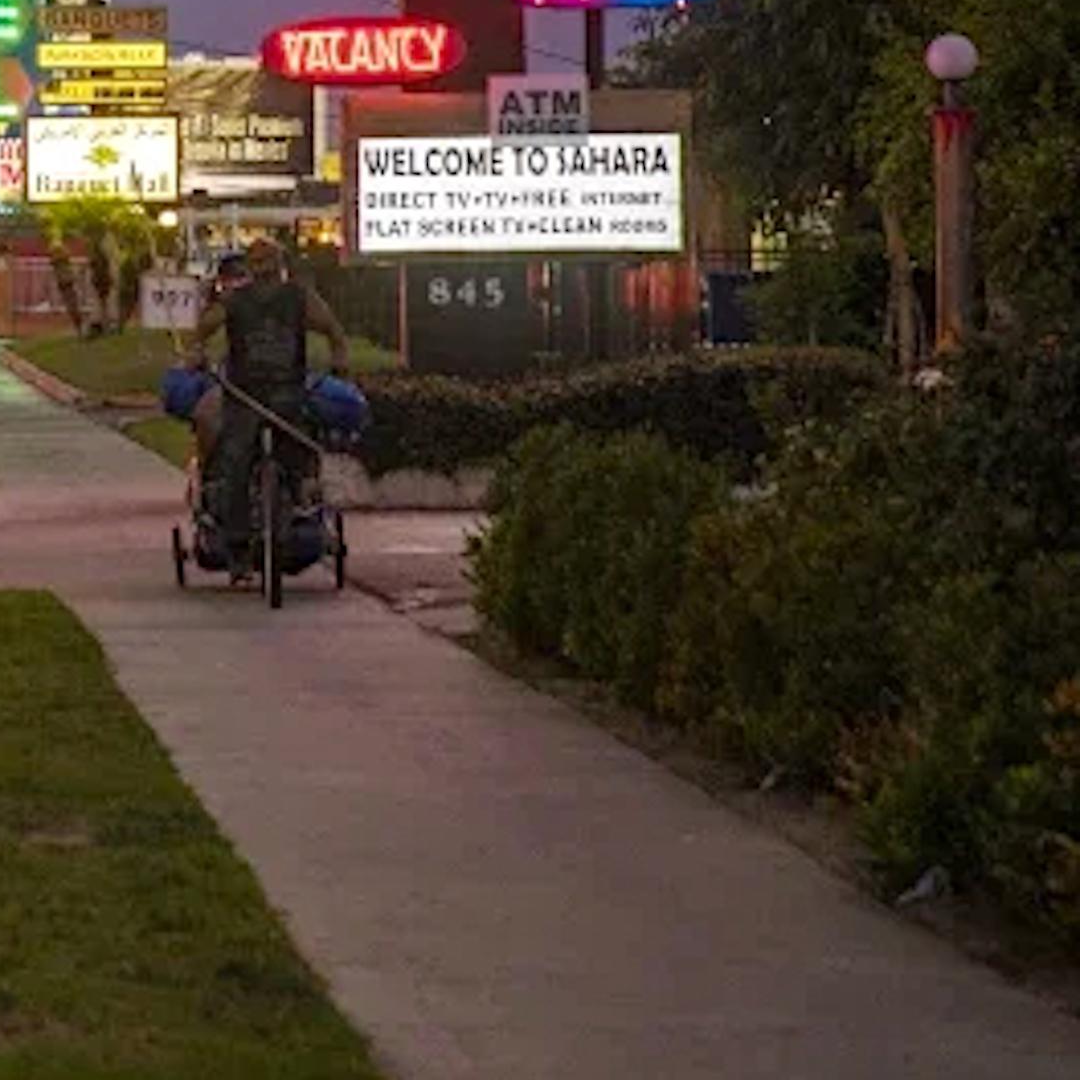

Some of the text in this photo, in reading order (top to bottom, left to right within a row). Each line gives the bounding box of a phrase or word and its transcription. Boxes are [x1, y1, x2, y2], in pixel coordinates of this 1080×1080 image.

[280, 22, 448, 73] VACANCY
[499, 90, 581, 115] ATM
[364, 145, 671, 177] WELCOME TO SAHARA
[366, 192, 438, 209] DIRECT
[427, 276, 505, 309] 845
